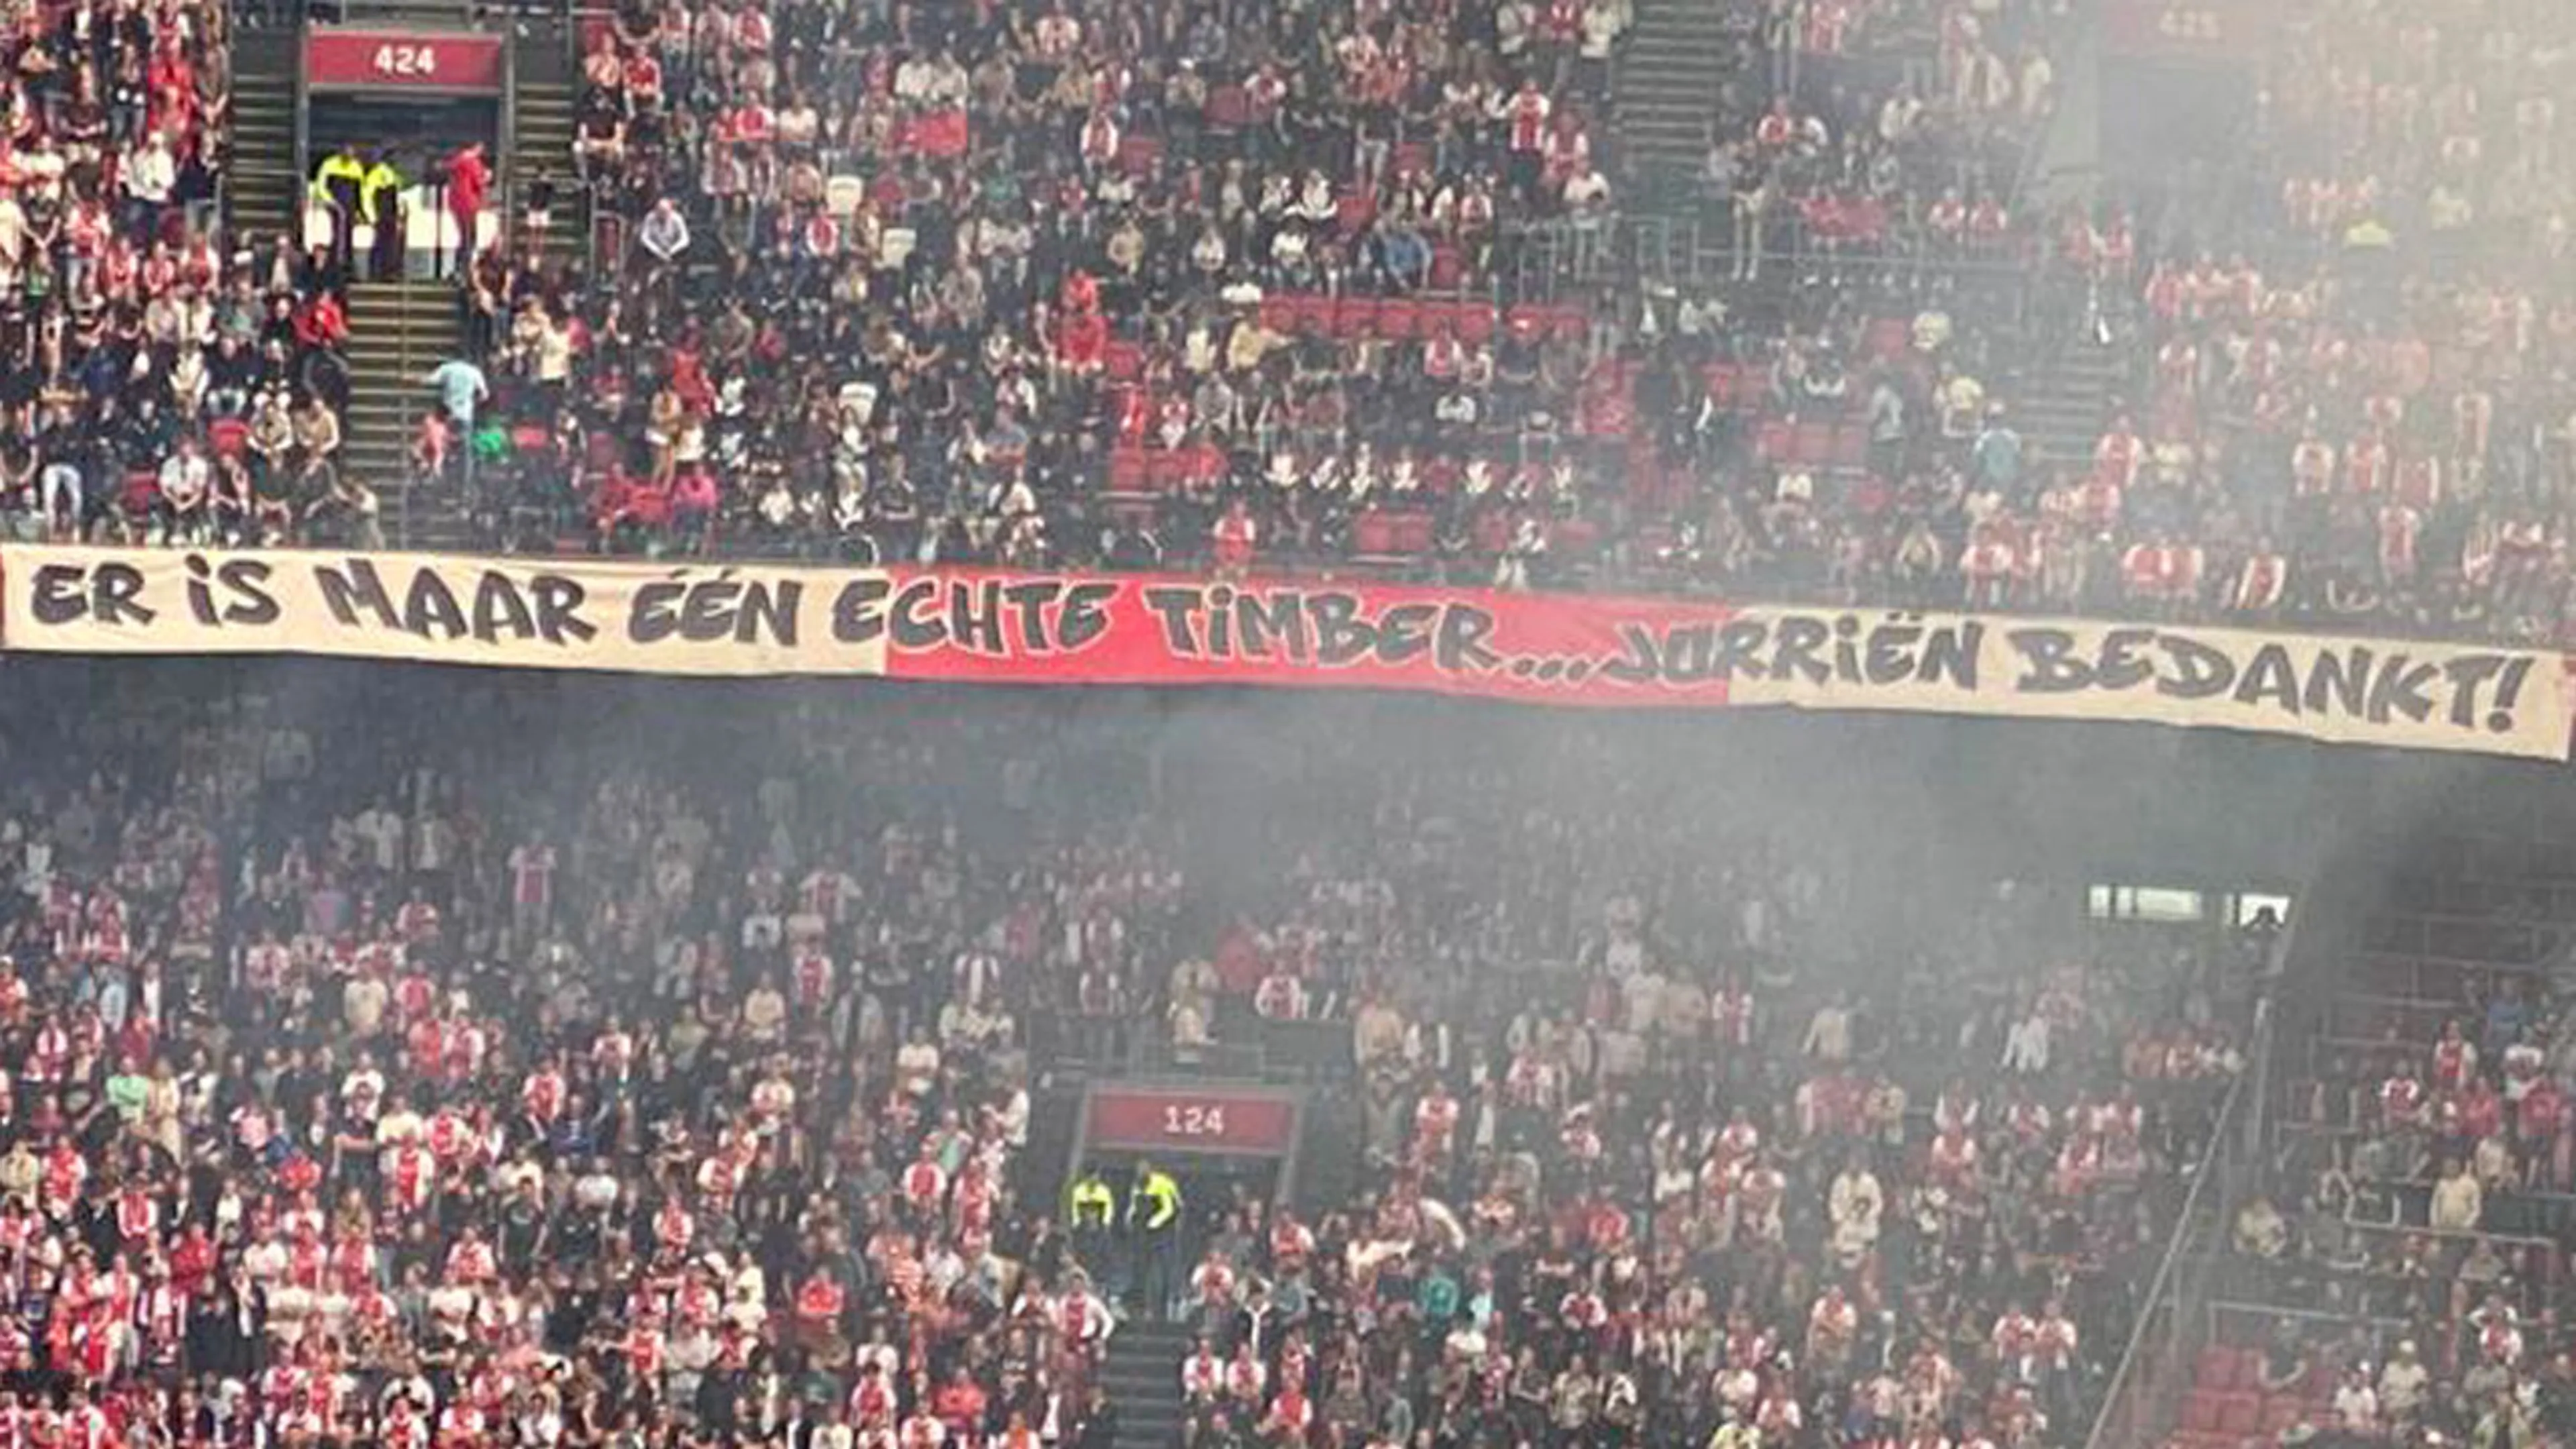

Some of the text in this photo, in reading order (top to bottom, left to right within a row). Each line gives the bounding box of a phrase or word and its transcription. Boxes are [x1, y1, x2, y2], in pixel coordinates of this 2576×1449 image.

[374, 44, 435, 74] 424
[31, 562, 157, 625] ER
[314, 558, 598, 645] MAAR
[629, 568, 804, 647] ÉÉN
[832, 581, 1118, 655] ECHTE
[2006, 627, 2536, 734] BEDANKT!
[1164, 1106, 1224, 1135] 124
